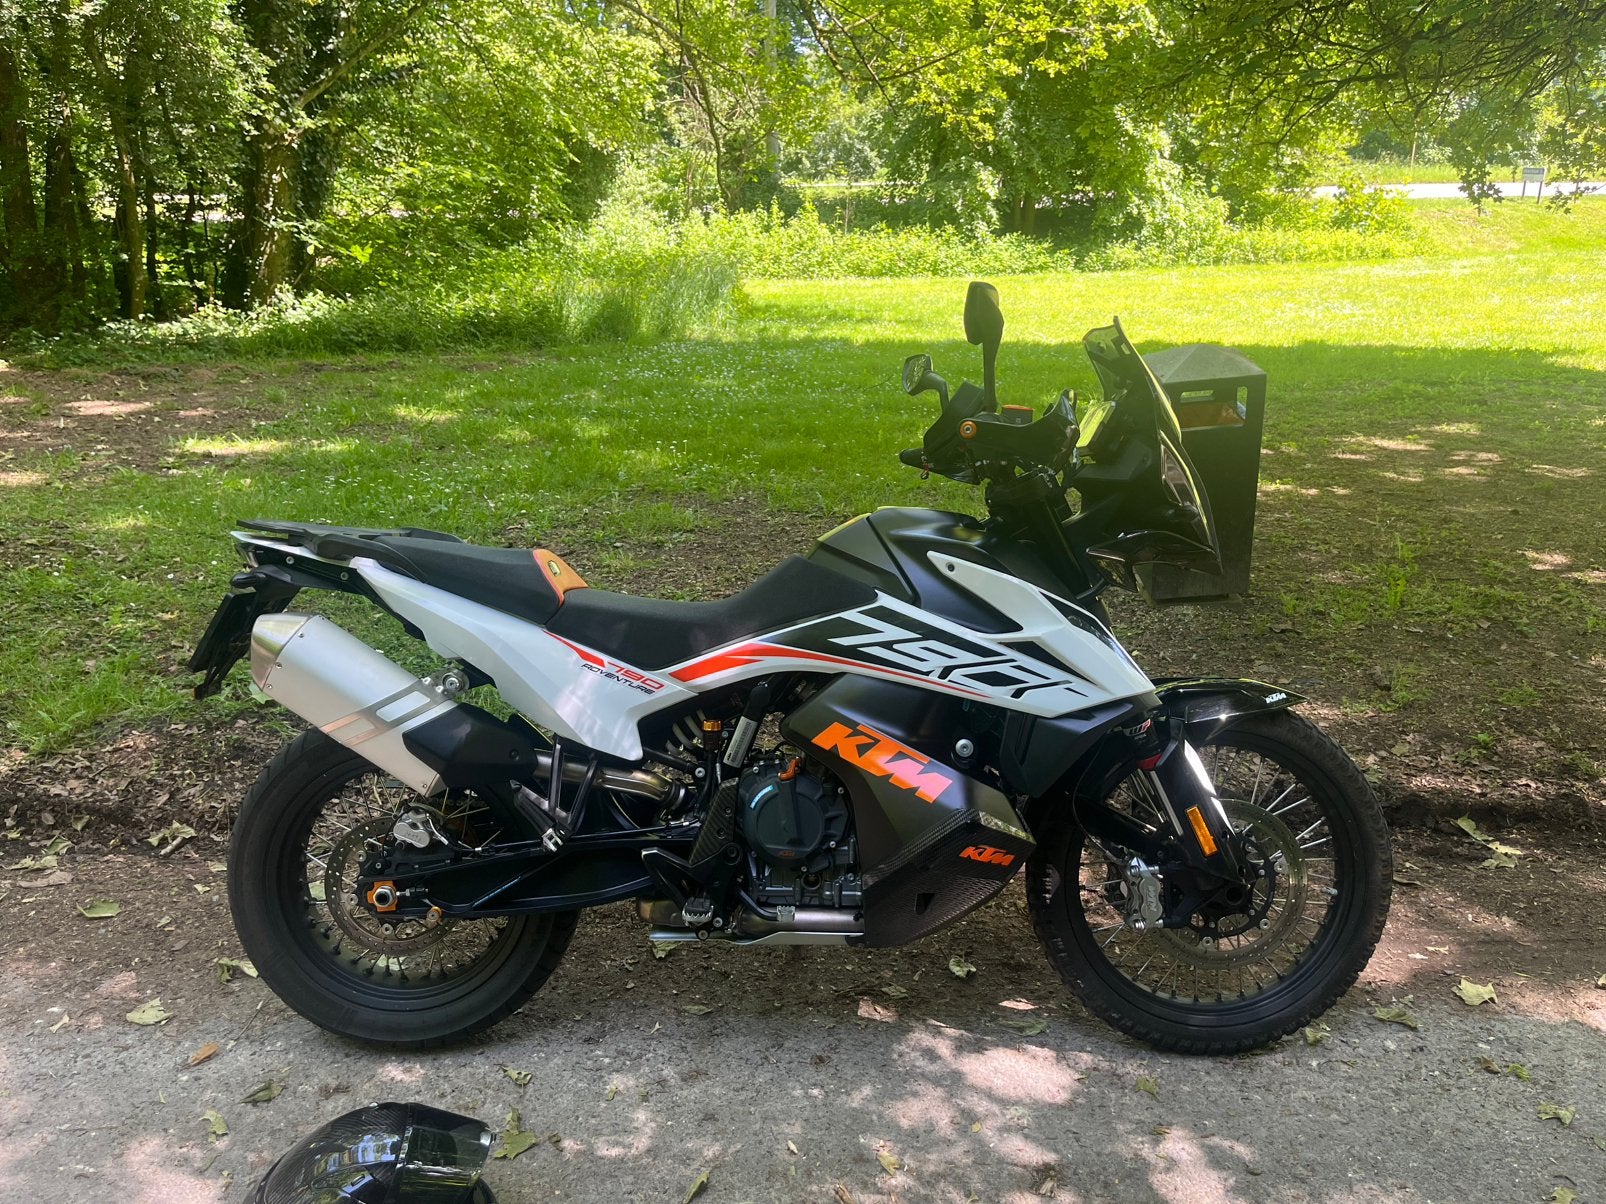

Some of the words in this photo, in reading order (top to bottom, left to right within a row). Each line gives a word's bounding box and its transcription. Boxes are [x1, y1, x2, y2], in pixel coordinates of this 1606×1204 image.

[827, 610, 1058, 698] 790
[581, 663, 655, 695] ADVENTURE
[607, 661, 665, 690] 790
[1265, 692, 1287, 704] KTM
[811, 721, 952, 803] KTM
[959, 845, 1015, 866] KTM
